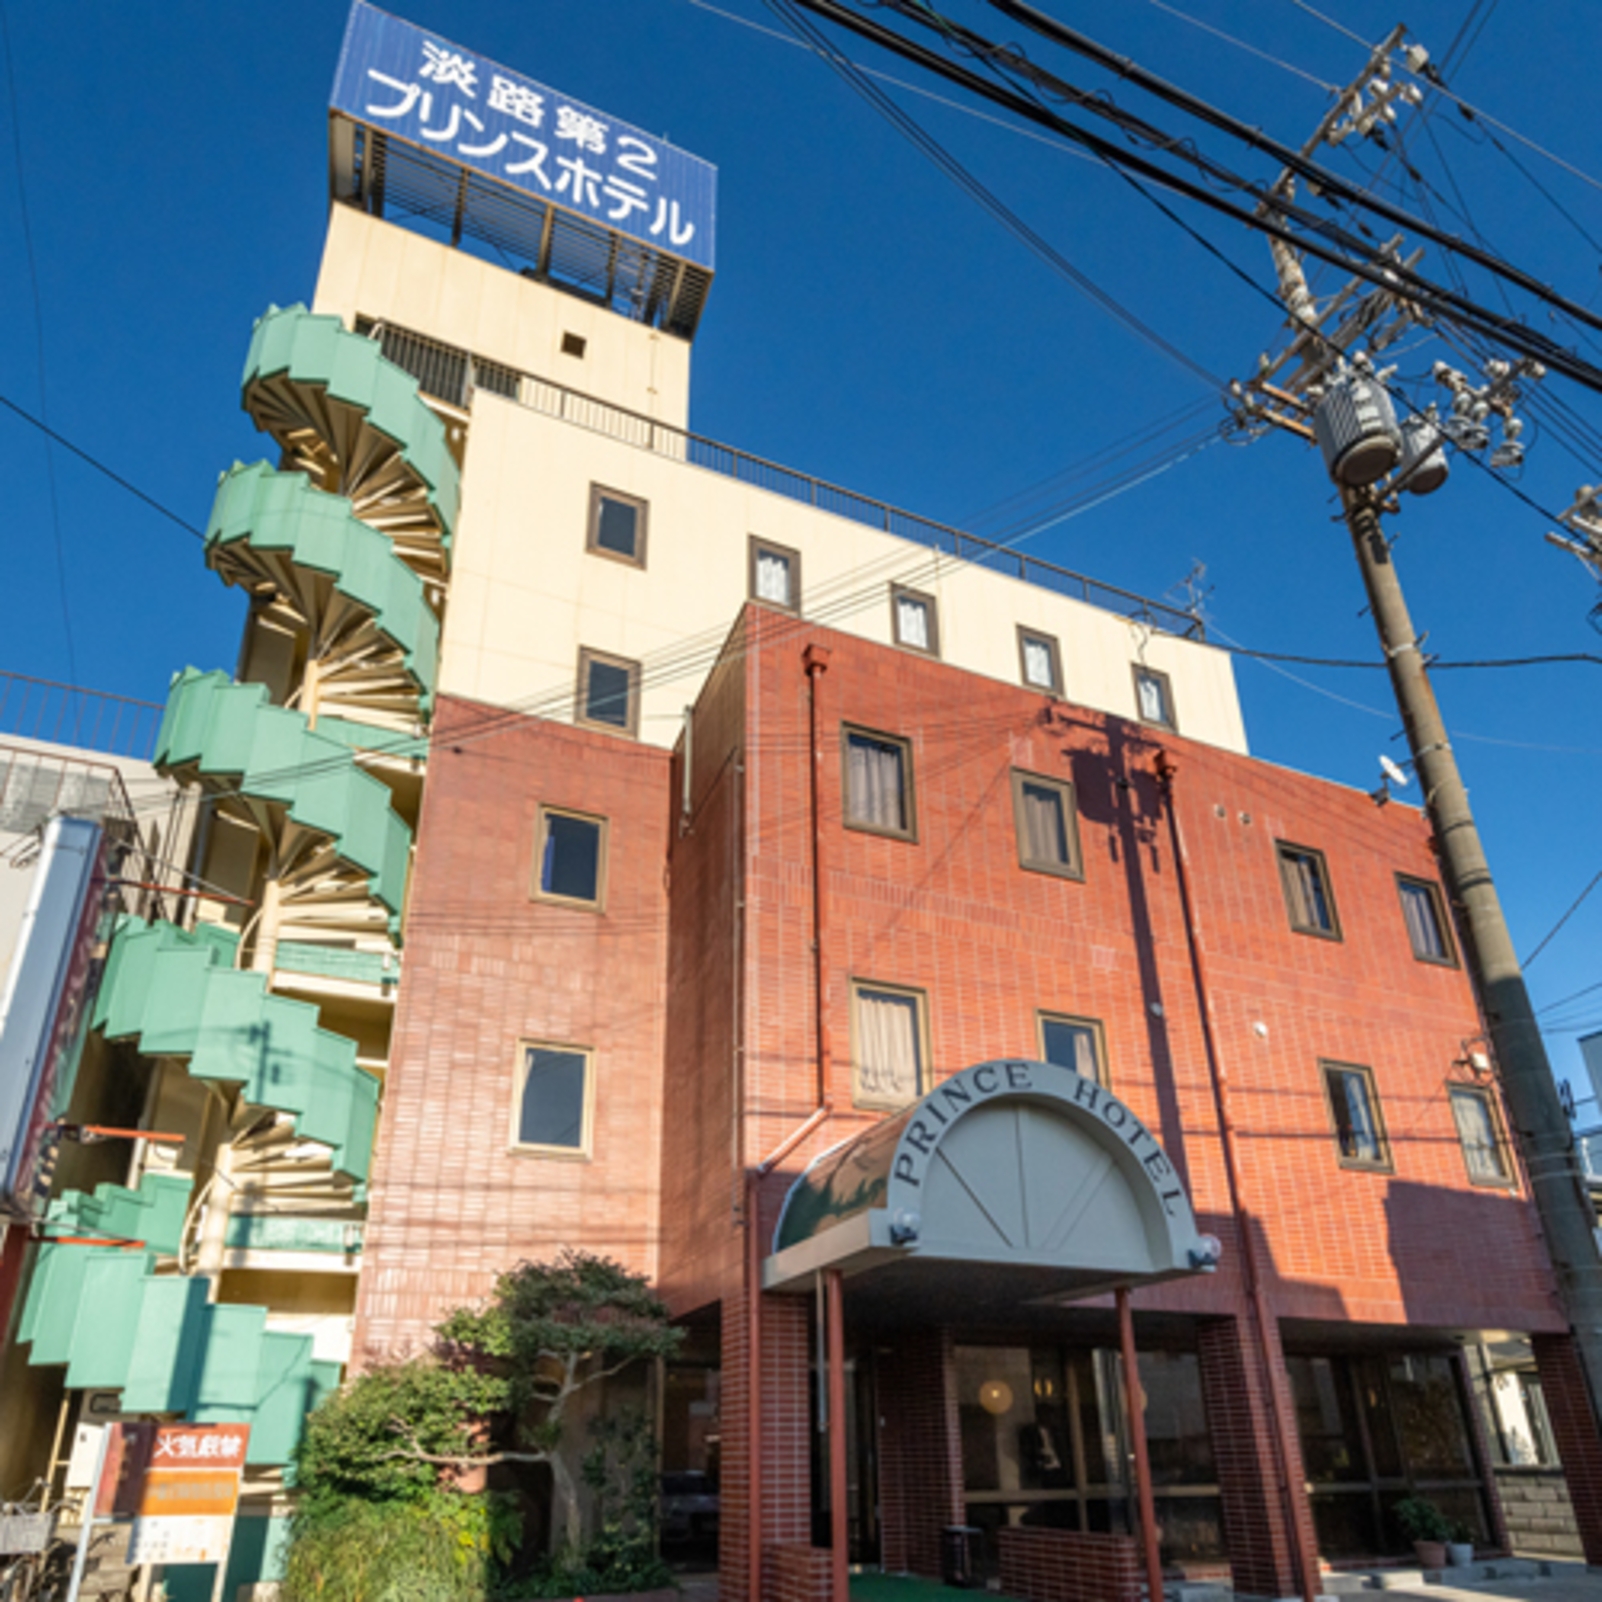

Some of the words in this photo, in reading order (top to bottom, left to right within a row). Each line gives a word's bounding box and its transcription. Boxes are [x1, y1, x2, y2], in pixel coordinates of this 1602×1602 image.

[366, 69, 694, 245] プリンスホテル
[419, 40, 658, 181] 淡路第2
[894, 1063, 1033, 1188] PRINCE
[1074, 1079, 1182, 1217] HOTEL
